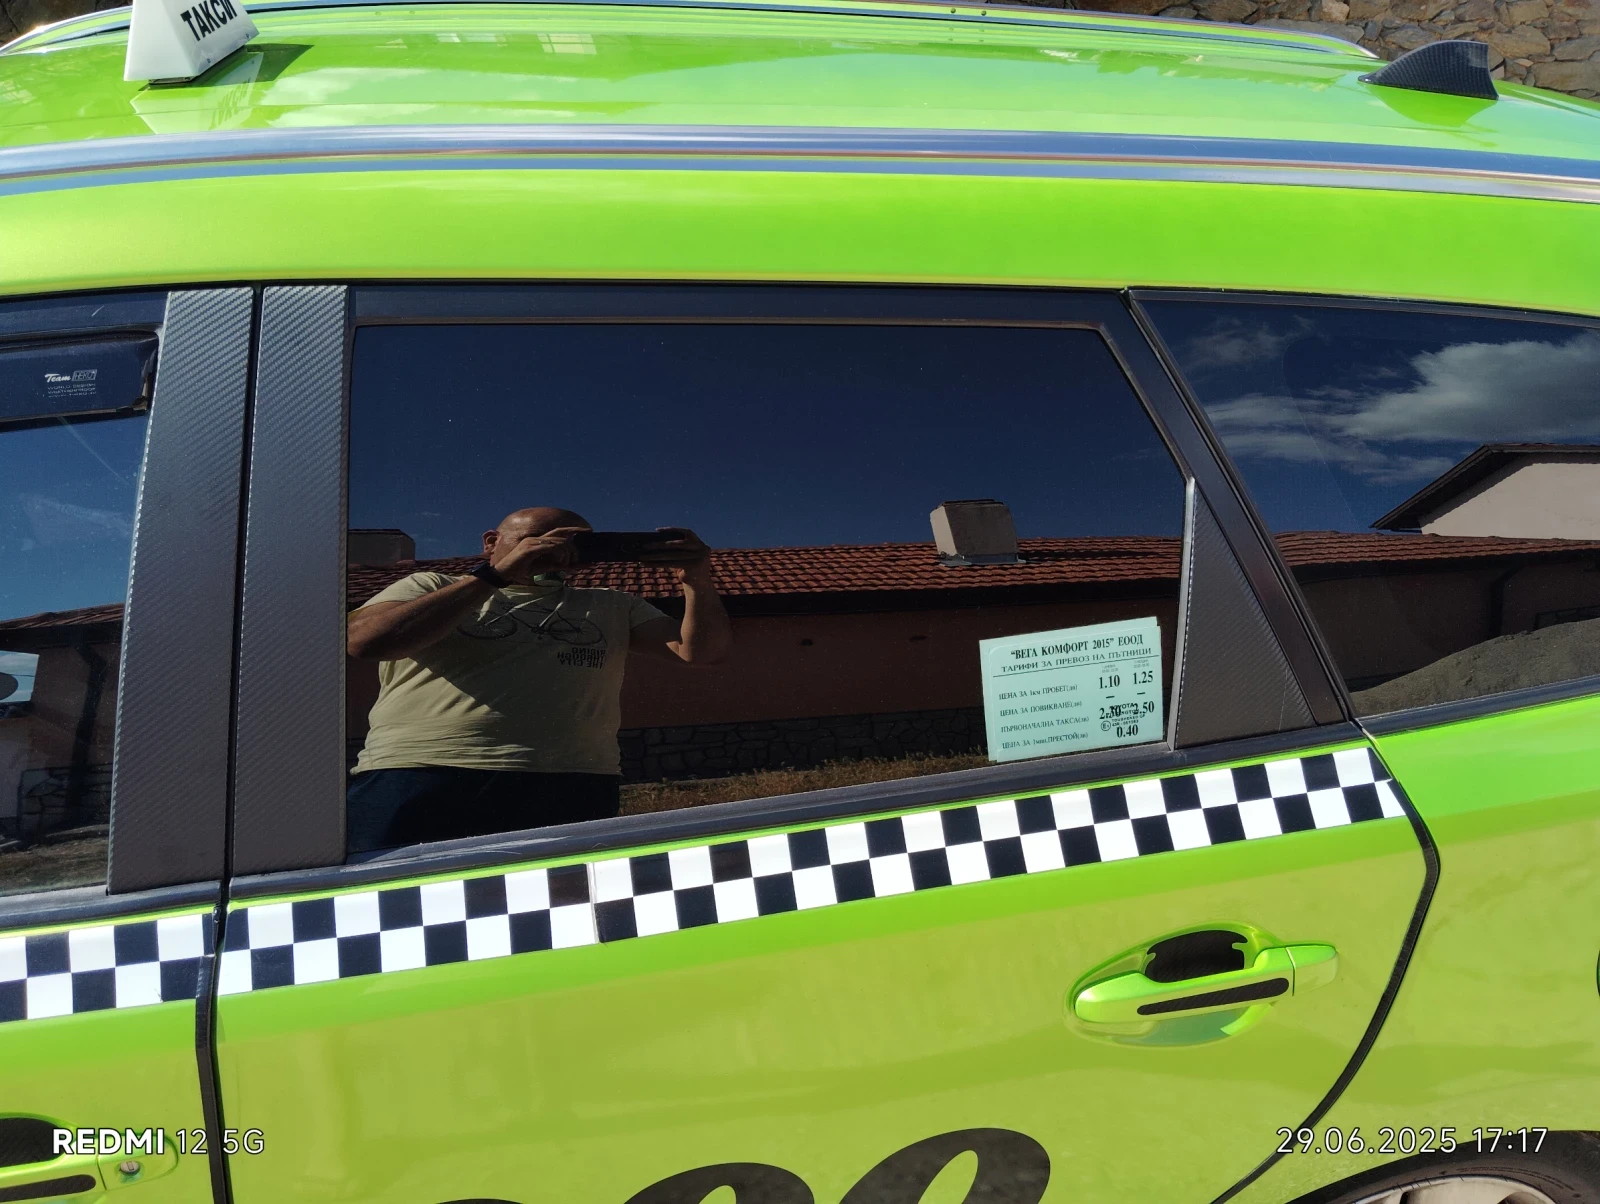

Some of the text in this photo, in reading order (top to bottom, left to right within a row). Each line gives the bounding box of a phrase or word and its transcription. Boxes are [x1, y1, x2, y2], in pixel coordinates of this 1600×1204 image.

[180, 0, 238, 41] ТАКСИ
[44, 373, 71, 383] Team
[1041, 640, 1089, 656] КОМФОРТ
[1118, 634, 1143, 647] ЕООД
[1001, 647, 1152, 673] ТАРИФИ ЗА ПРЕВОЗ НА ПЪТНИЦИ
[1098, 670, 1154, 689] 1.10 1.25
[998, 692, 1018, 700] ЦЕНА
[1019, 690, 1028, 698] ЗА
[1000, 708, 1019, 717] ЦЕНА
[1133, 700, 1155, 715] 2.50
[1001, 720, 1055, 733] ПЪРВОНАЧАЛНА
[1116, 724, 1139, 739] 0.40
[1002, 741, 1021, 749] ЦЕНА
